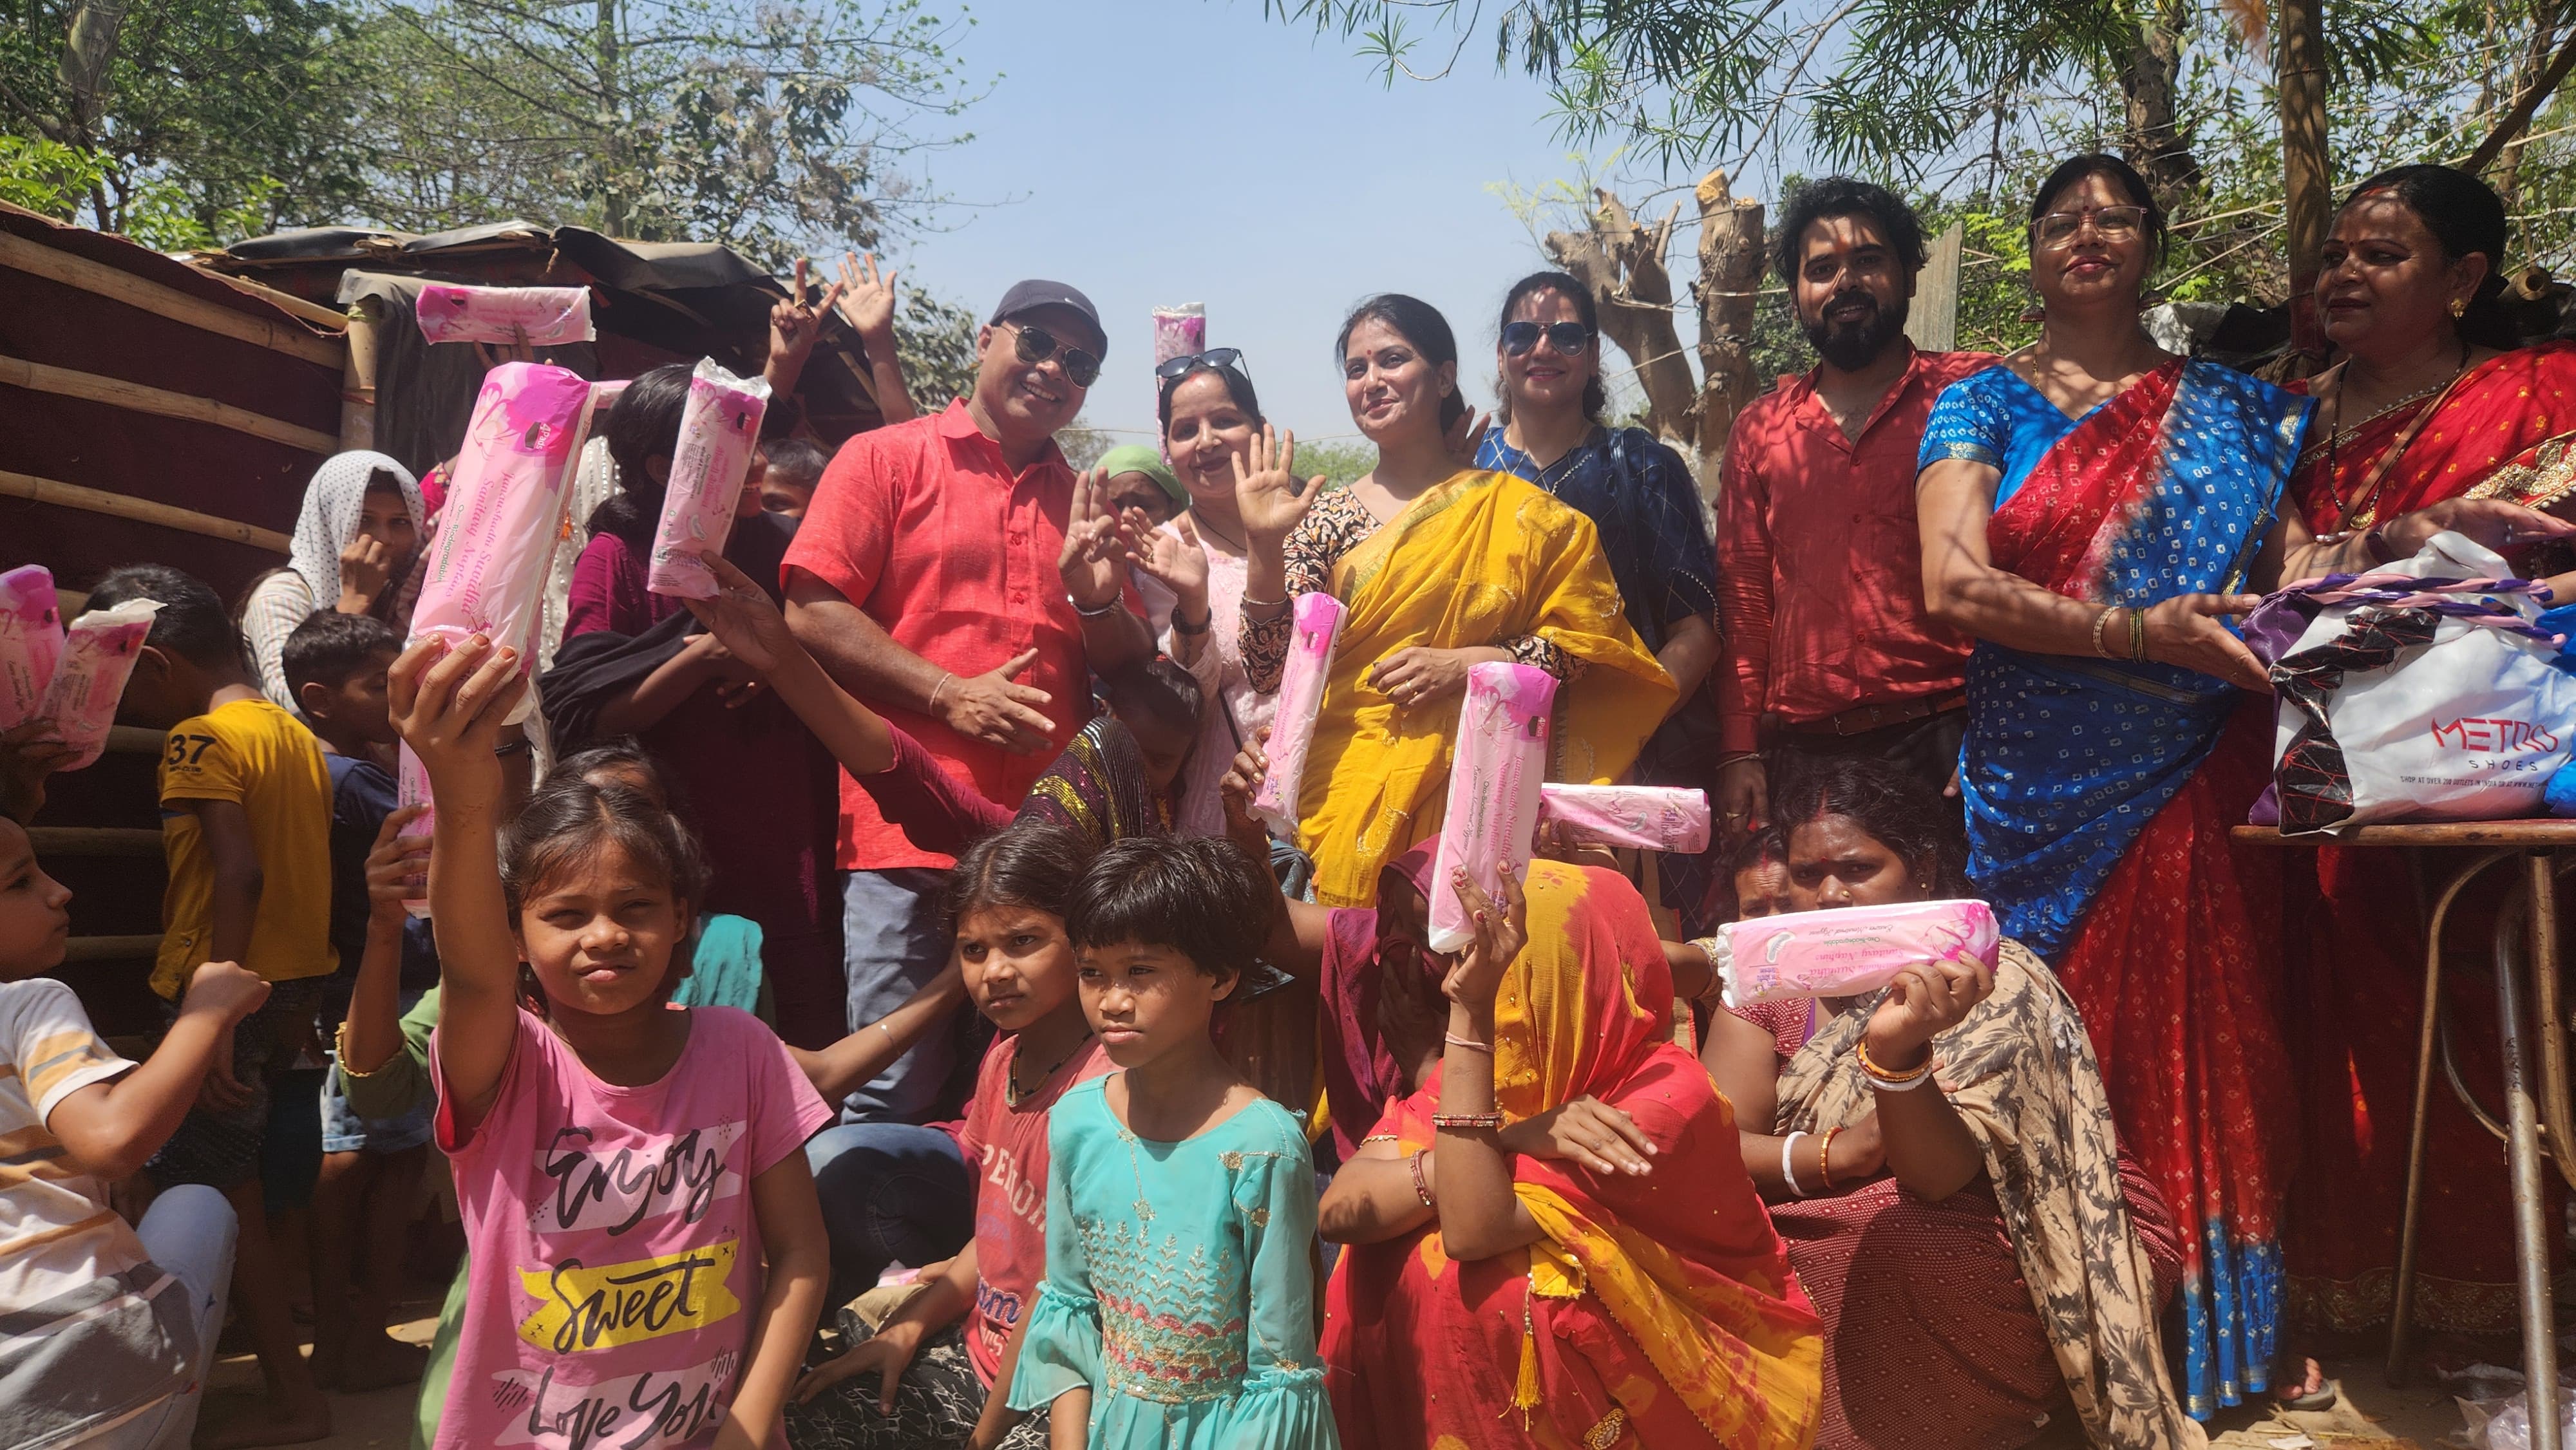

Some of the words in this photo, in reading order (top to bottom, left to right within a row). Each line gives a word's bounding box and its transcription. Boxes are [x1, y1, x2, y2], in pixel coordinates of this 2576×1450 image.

[466, 477, 495, 537] Sanitary
[437, 504, 466, 581] O-Biodegradable
[446, 541, 476, 598] Napkins
[461, 550, 493, 616] Suvidha
[167, 734, 218, 766] 37
[2431, 717, 2559, 753] METRO
[1495, 762, 1510, 804] Sanitary
[1510, 754, 1524, 812] Janaushadhi
[2468, 760, 2538, 771] SHOES
[1489, 808, 1501, 852] Napkins
[1501, 813, 1517, 860] Suvidha
[1808, 965, 1855, 978] Suvidha
[1815, 950, 1856, 961] Napkins
[1861, 946, 1904, 959] Sanitary
[545, 1127, 726, 1236] Enjoy
[551, 1254, 715, 1354] Sweet
[528, 1364, 621, 1450] Love
